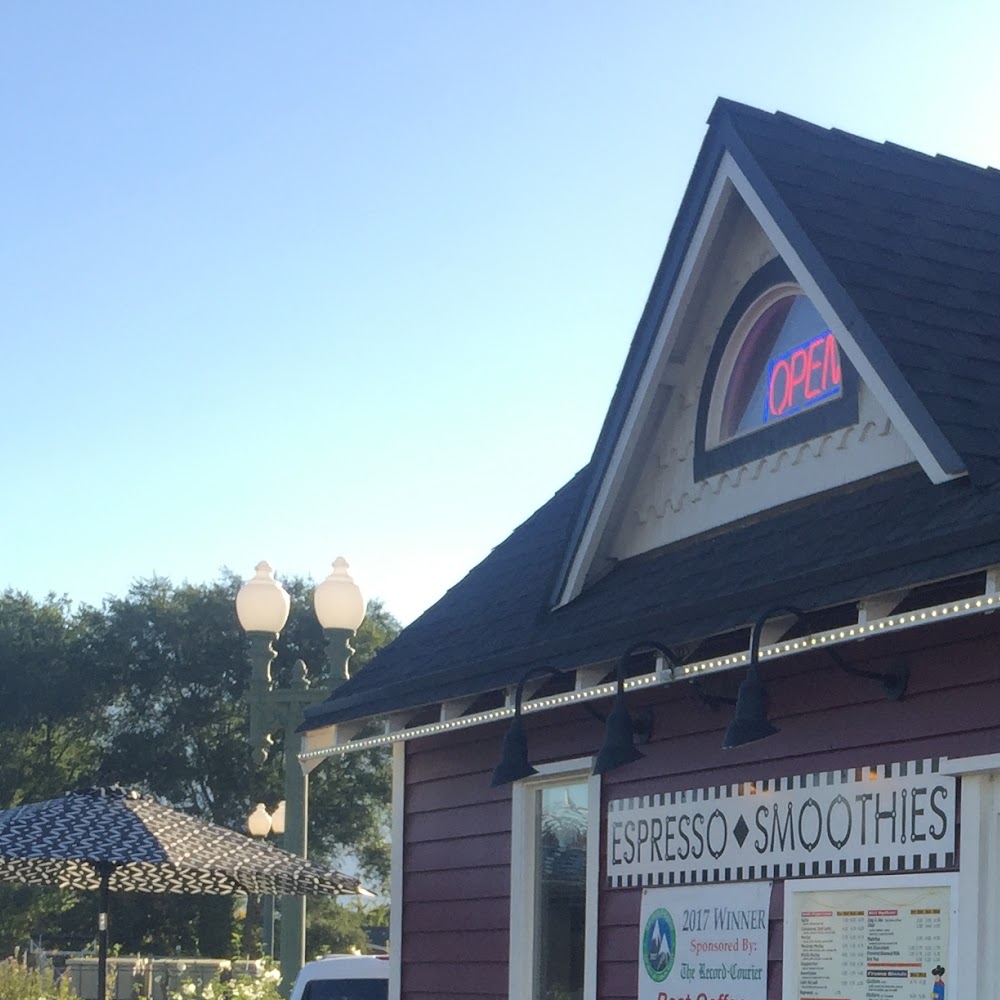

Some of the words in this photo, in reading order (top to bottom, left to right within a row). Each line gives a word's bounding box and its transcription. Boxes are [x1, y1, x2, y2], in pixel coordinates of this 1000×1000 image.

[769, 333, 842, 416] OPEN
[612, 808, 728, 866] ESPRESSO
[755, 785, 948, 854] SMOOTHIES
[682, 908, 711, 932] 2017
[714, 906, 766, 931] WINNER
[690, 938, 739, 957] Sponsored
[742, 938, 757, 956] By:
[680, 962, 695, 983] The
[699, 962, 763, 981] Record-Courier
